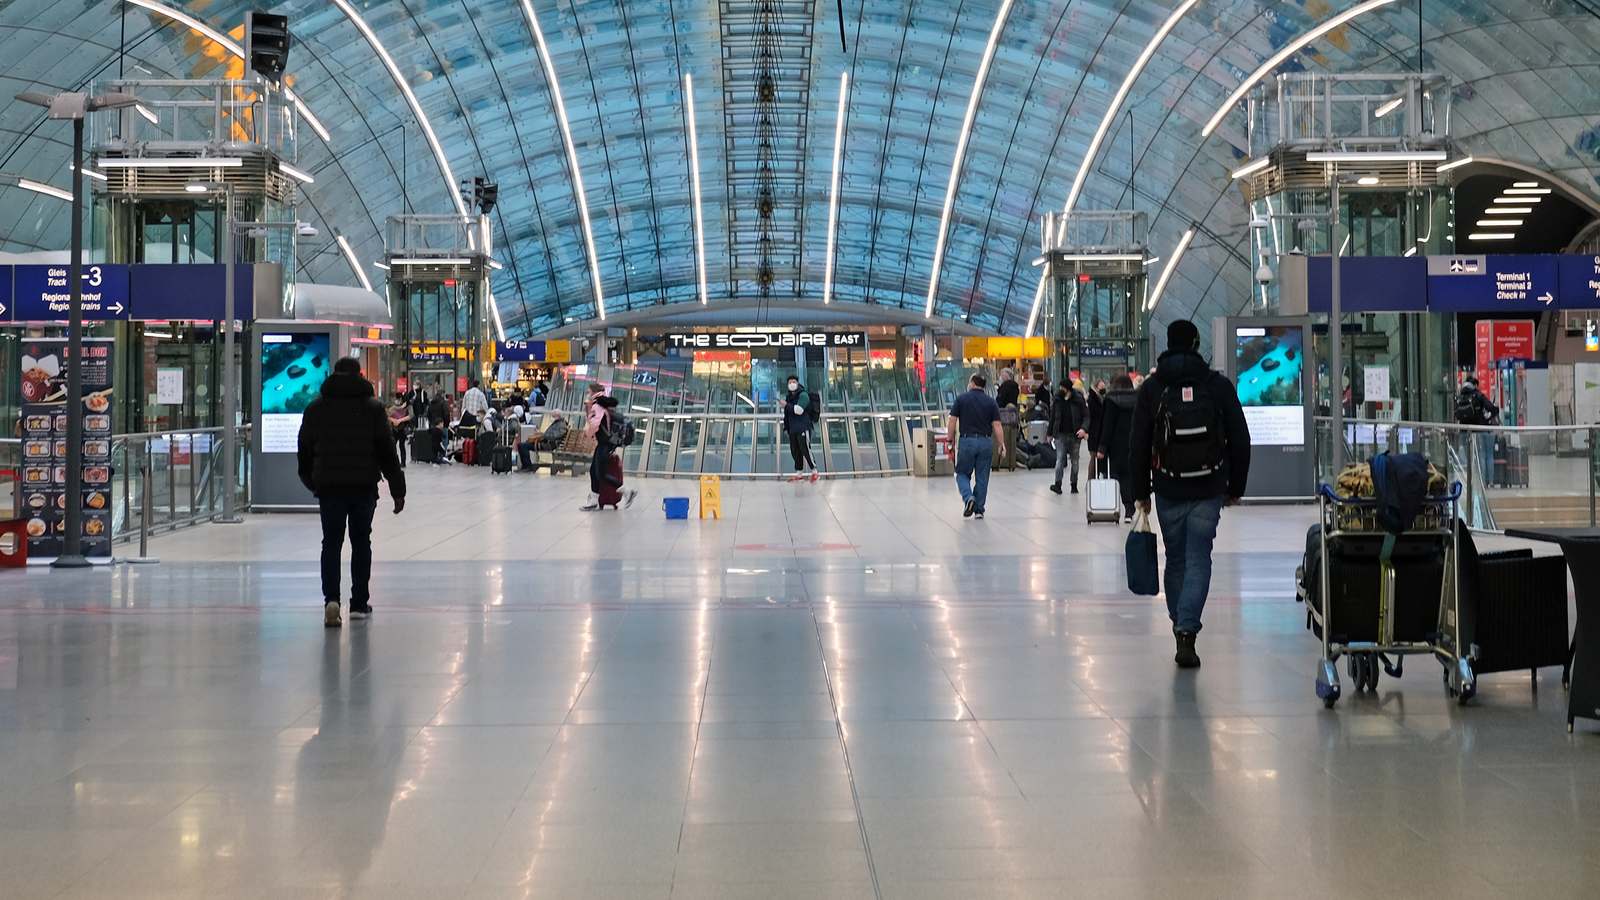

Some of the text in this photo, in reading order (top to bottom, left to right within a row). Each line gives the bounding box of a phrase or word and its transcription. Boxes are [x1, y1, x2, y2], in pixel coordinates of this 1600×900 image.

[48, 266, 102, 286] Gleis -3
[1496, 272, 1531, 281] Terminal 1
[48, 278, 67, 286] Track
[1496, 281, 1532, 290] Terminal 2
[1497, 291, 1518, 300] Check
[505, 340, 519, 349] 6-7
[669, 334, 710, 347] THE
[834, 335, 860, 344] EAST
